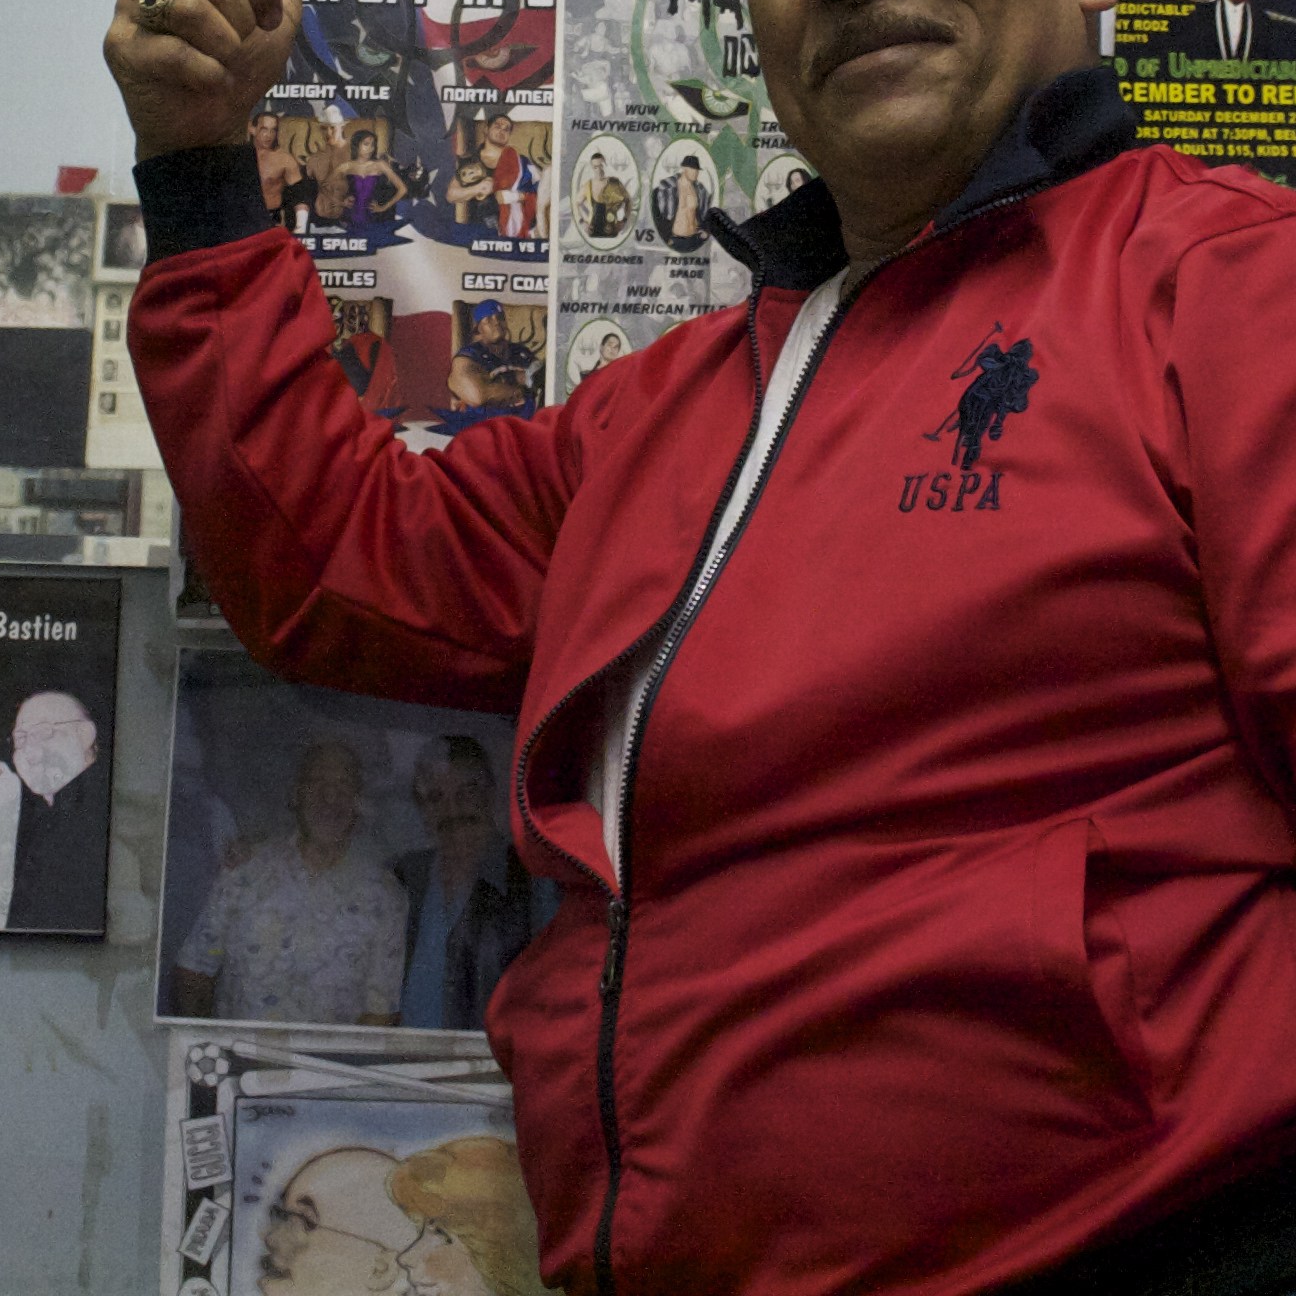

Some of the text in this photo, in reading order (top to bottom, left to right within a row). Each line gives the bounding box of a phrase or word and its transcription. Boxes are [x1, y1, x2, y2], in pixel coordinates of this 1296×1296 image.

[344, 85, 390, 101] TITLE
[444, 88, 498, 104] NORTH
[1118, 81, 1216, 104] CEMBER
[1222, 82, 1255, 105] TO
[624, 104, 661, 117] WUW
[1143, 109, 1213, 123] SATURDAY
[1215, 110, 1286, 124] DECEMBER
[571, 119, 713, 135] HEAVYWEIGHT TITLE
[634, 228, 656, 244] VS
[322, 238, 369, 252] SPADE
[471, 240, 537, 254] ASTRO VS
[318, 270, 375, 288] TITLES
[463, 274, 507, 291] EAST
[560, 302, 687, 316] NORTH AMERICAN
[897, 470, 1005, 514] USPA
